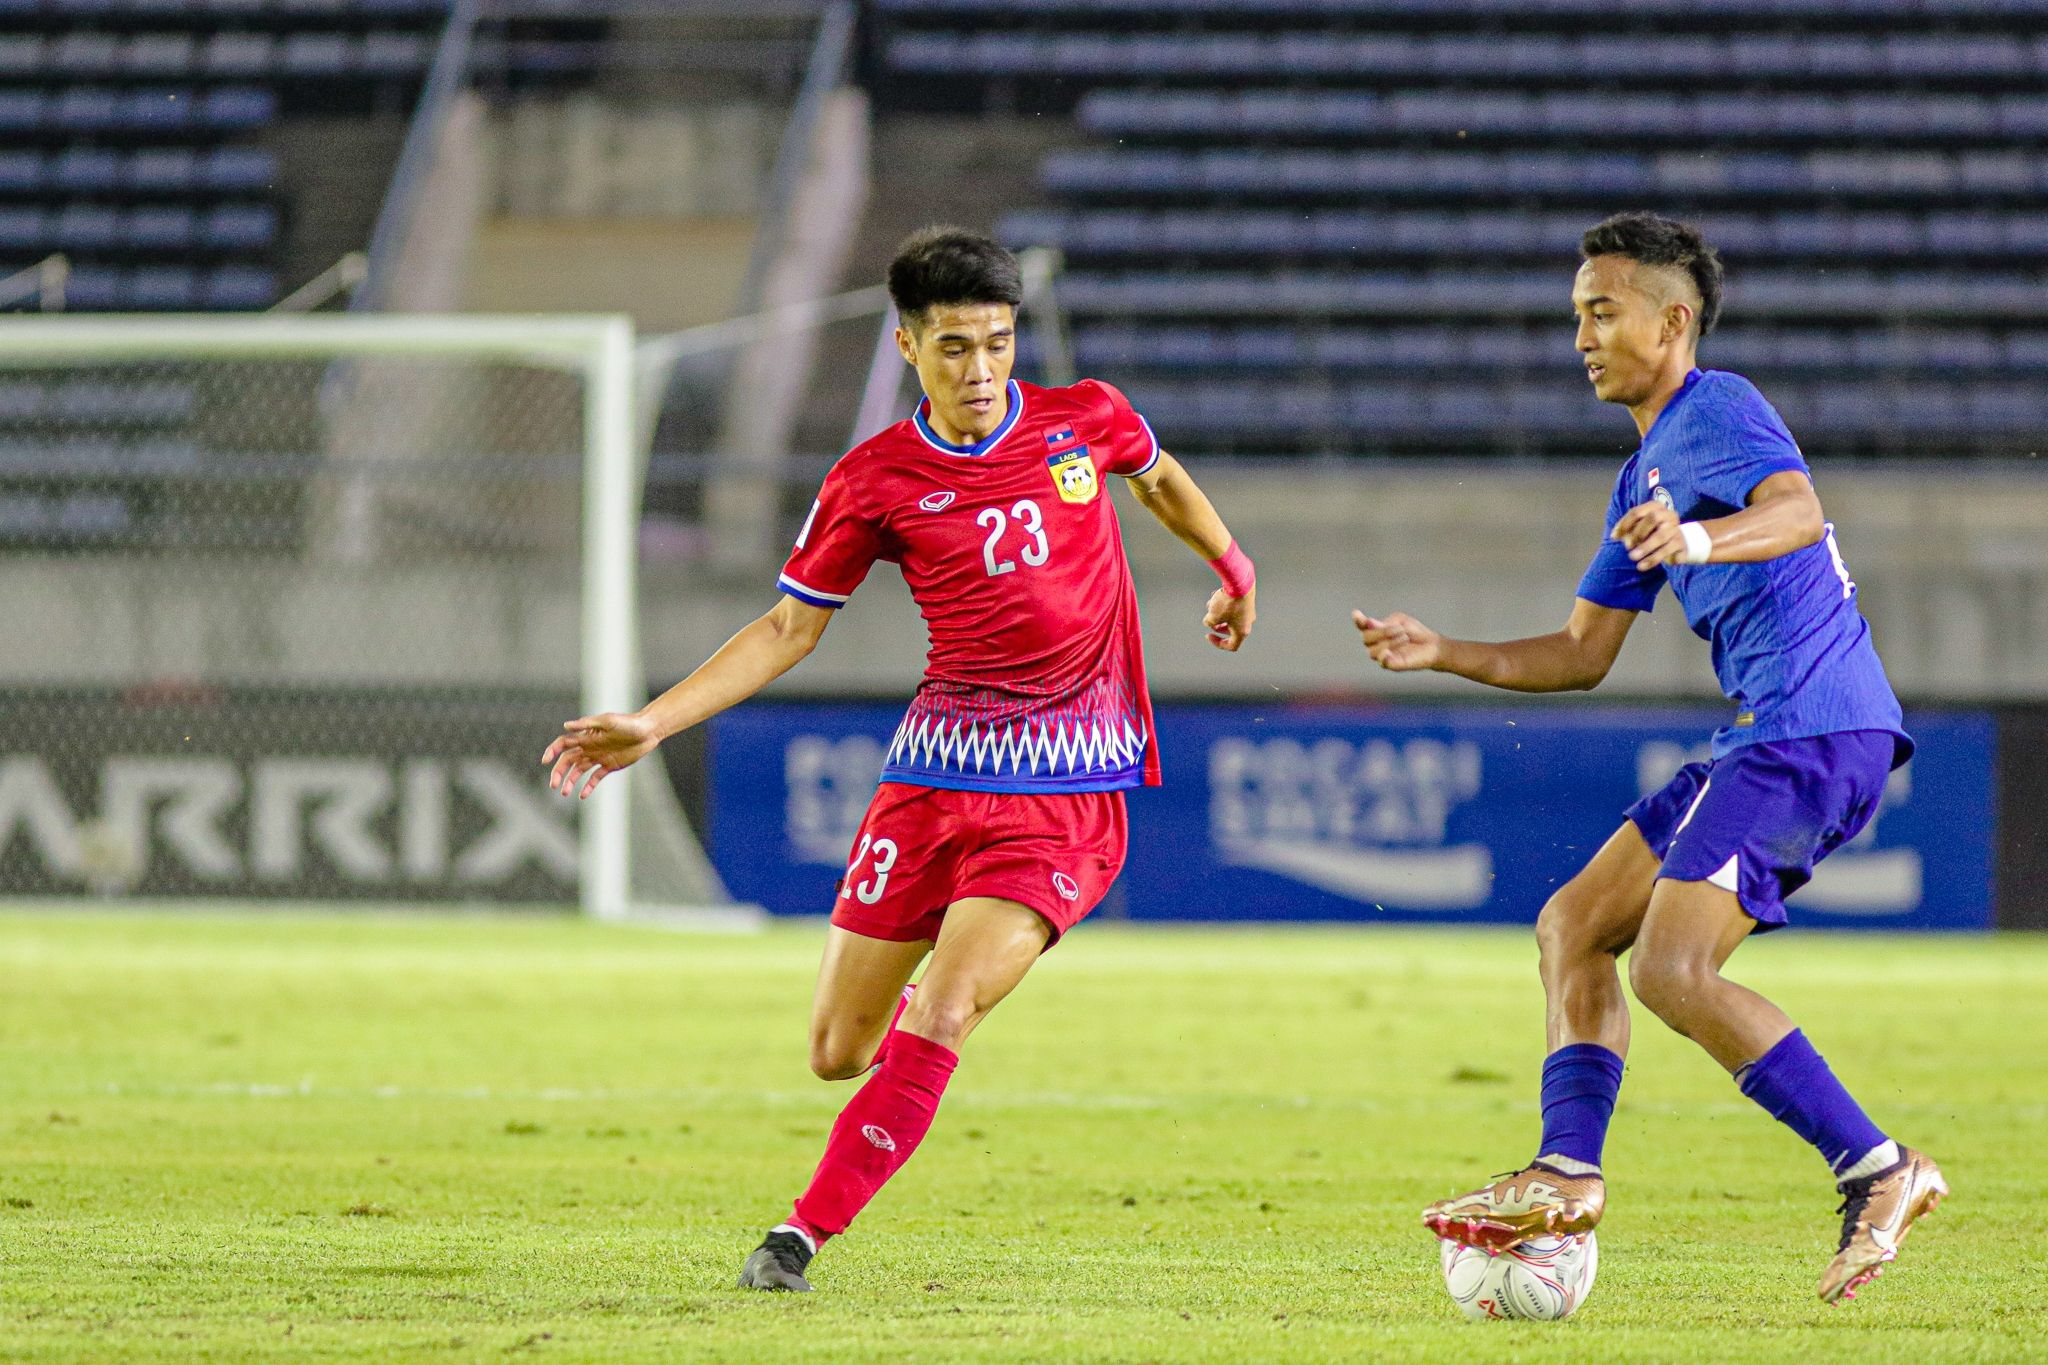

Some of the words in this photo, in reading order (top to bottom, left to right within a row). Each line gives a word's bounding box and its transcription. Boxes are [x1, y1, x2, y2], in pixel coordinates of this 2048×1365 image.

[1059, 452, 1078, 463] LAOS
[976, 499, 1049, 577] 23
[840, 832, 898, 905] 23
